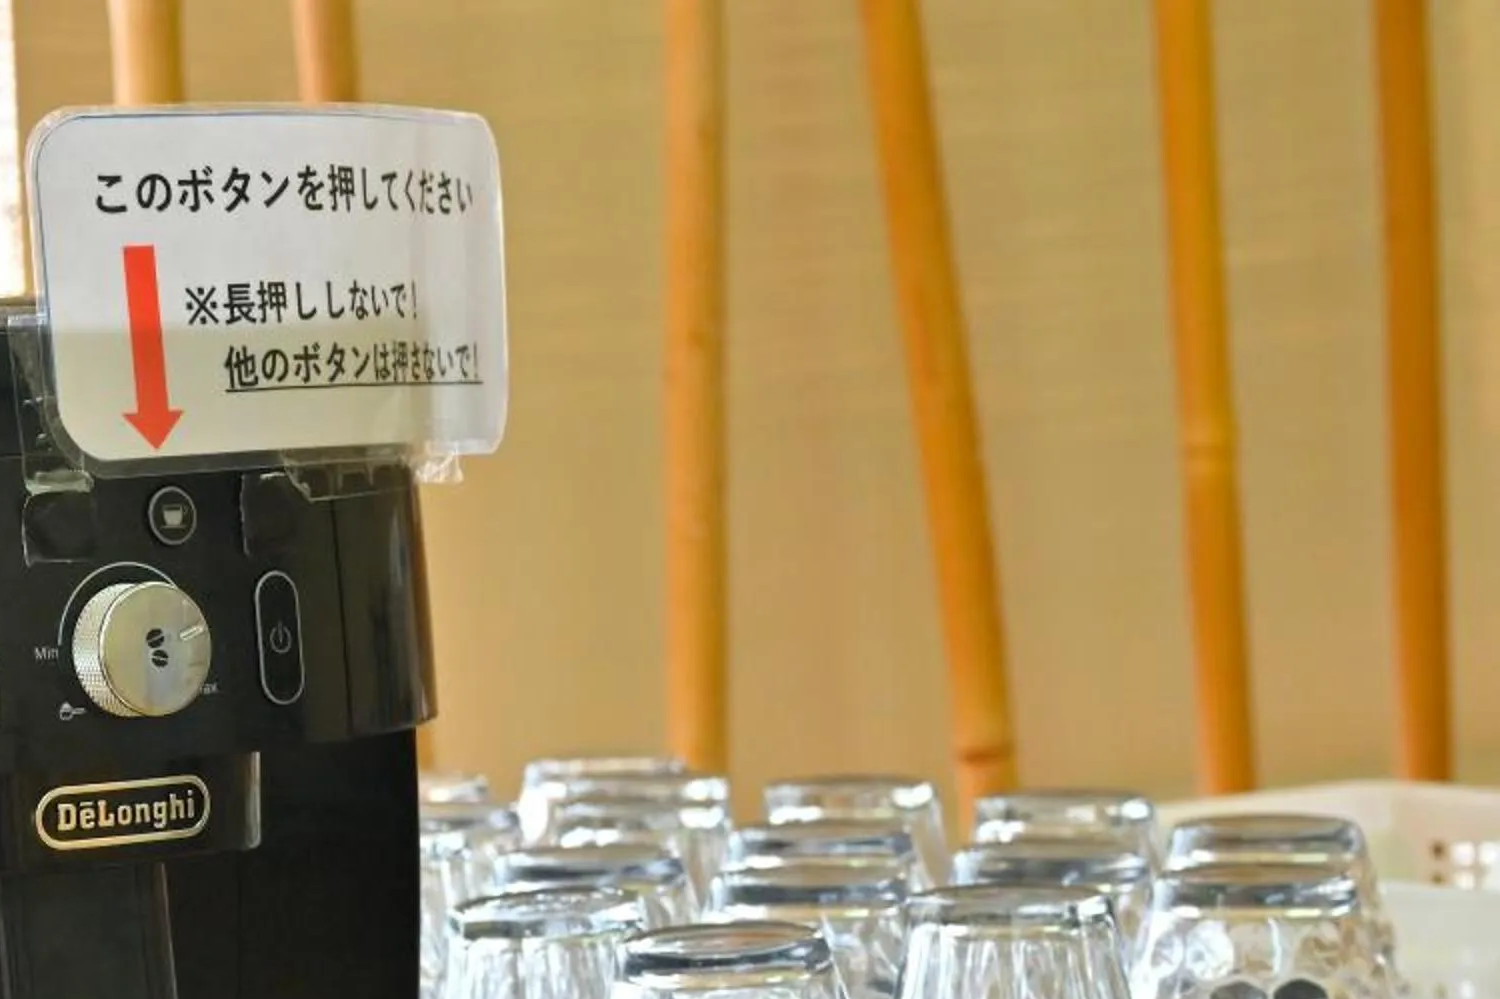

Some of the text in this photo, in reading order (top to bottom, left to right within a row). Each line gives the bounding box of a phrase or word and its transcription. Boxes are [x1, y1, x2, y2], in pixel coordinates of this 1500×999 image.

[95, 162, 474, 216] このボタンを押してください
[34, 647, 59, 660] Min
